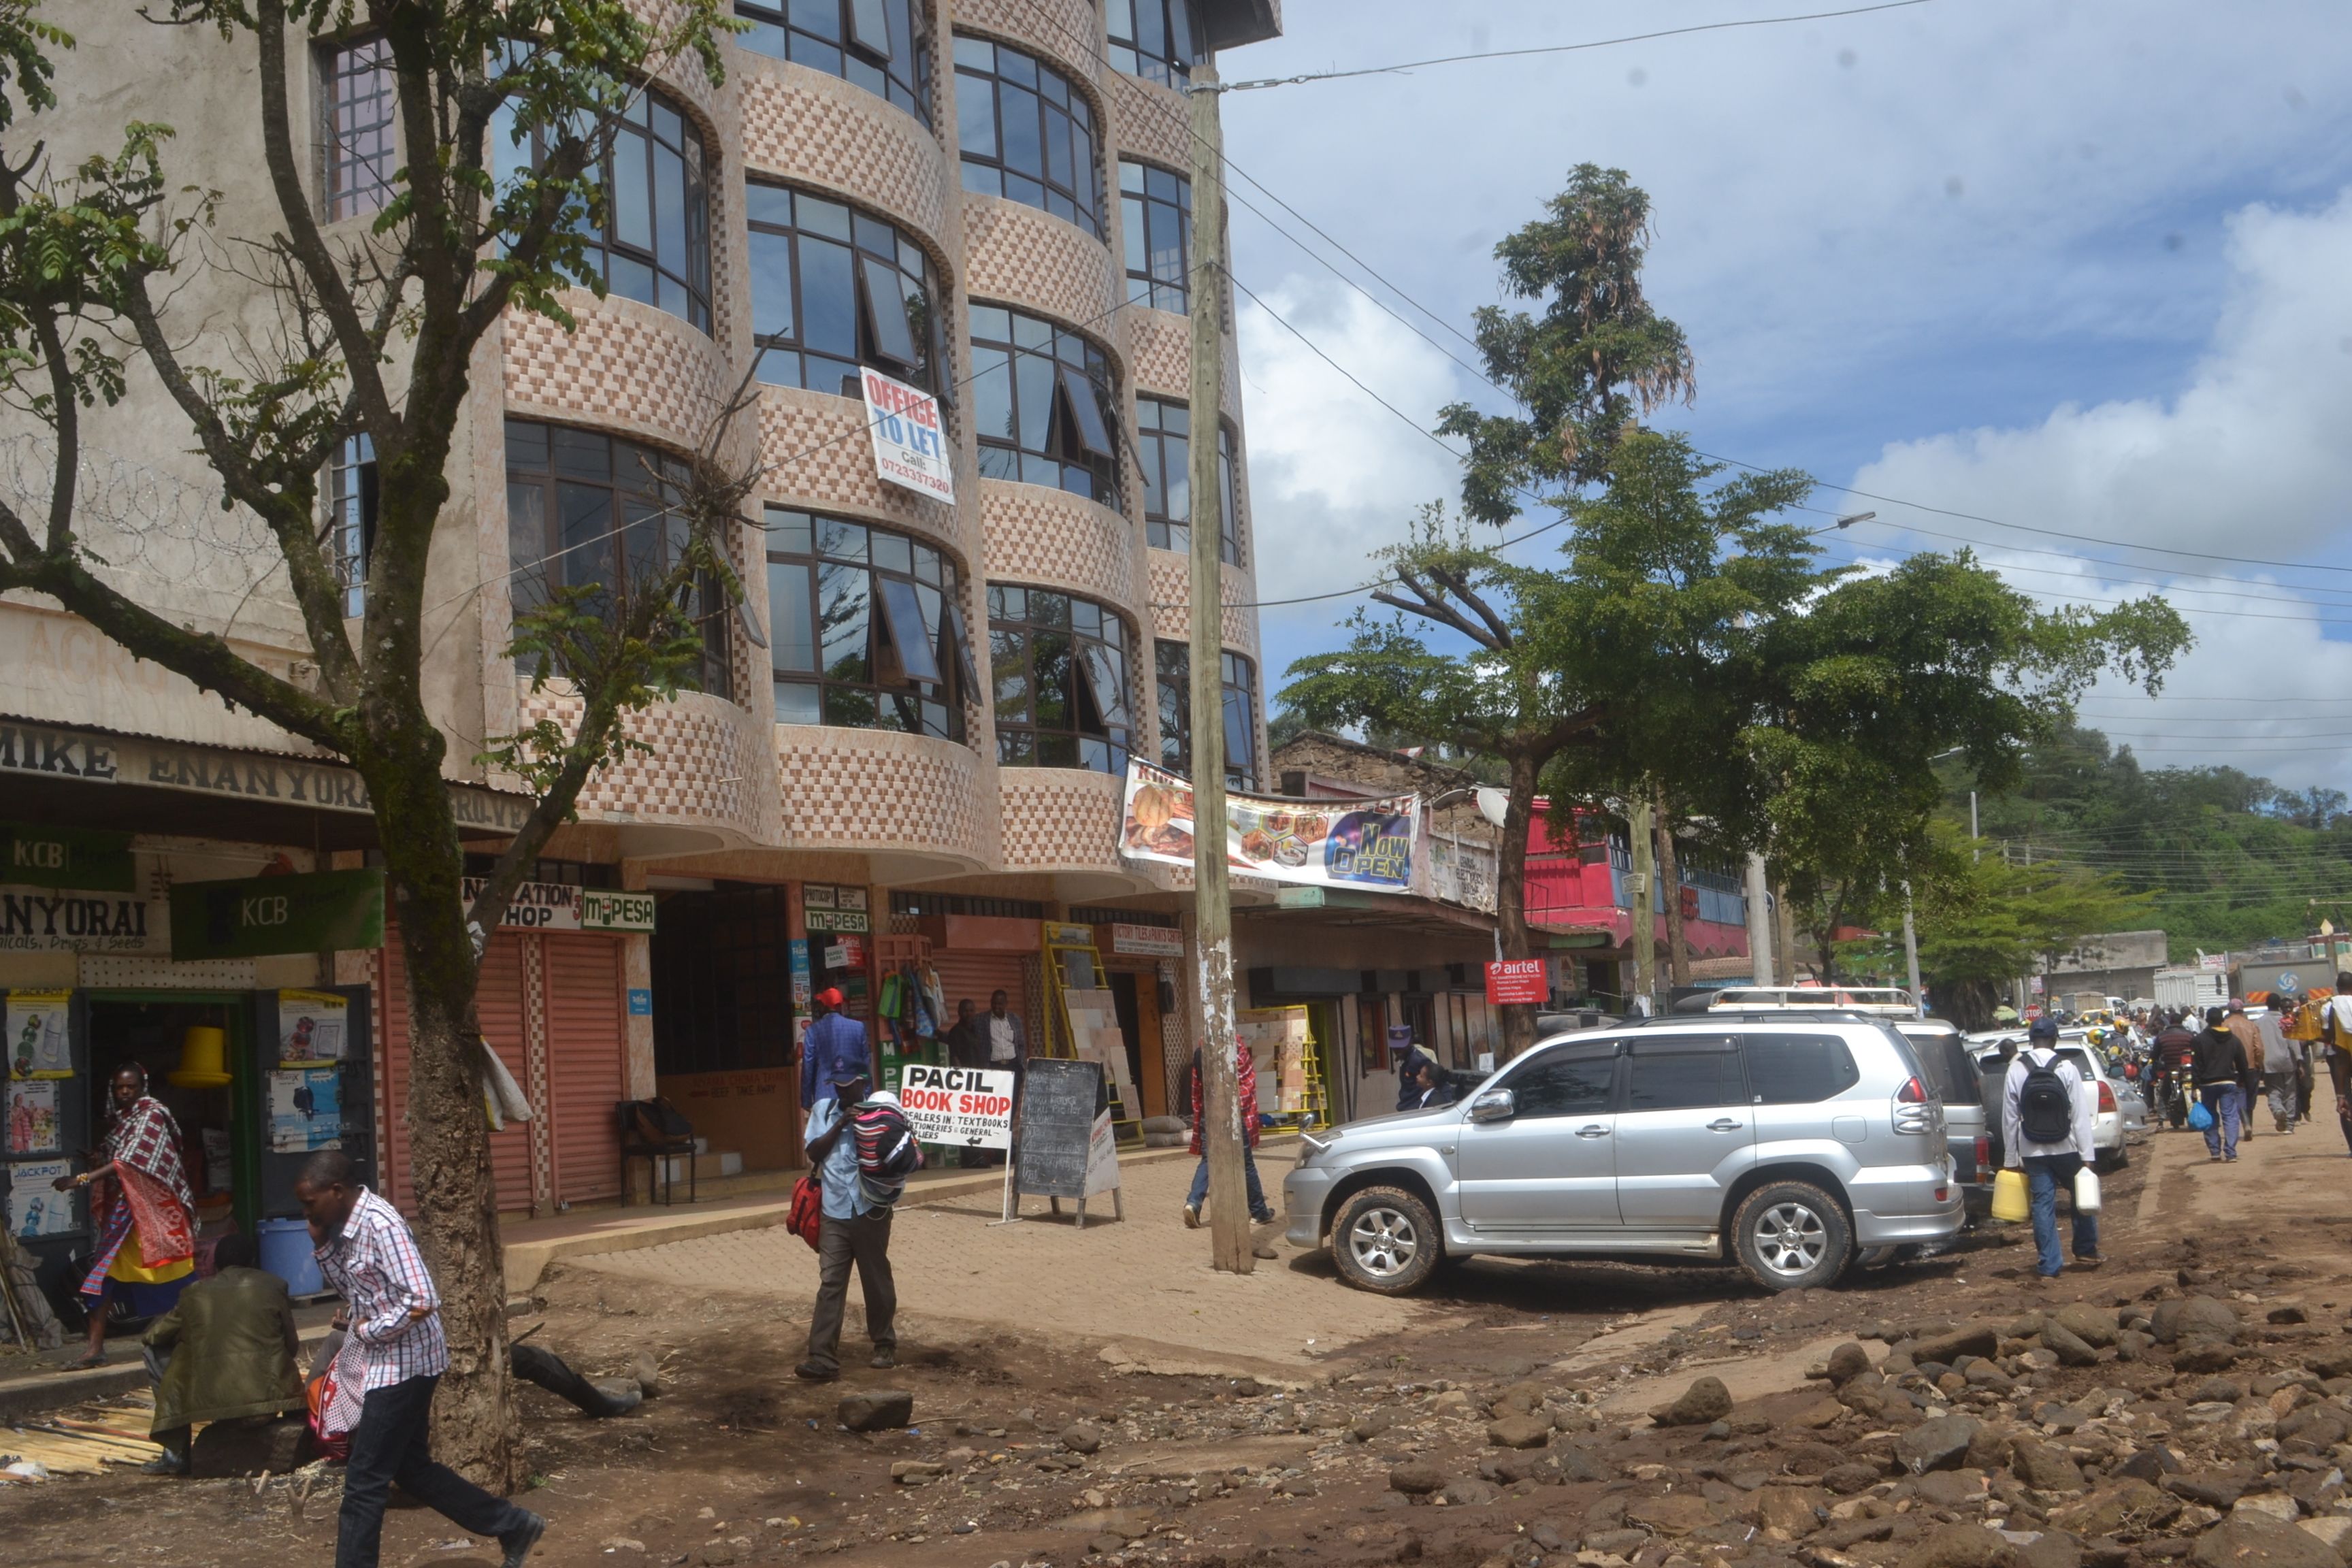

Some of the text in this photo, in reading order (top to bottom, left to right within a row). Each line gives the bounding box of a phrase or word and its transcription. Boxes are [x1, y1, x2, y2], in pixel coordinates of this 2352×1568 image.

[866, 374, 937, 429] OFFICE
[874, 407, 940, 459] TO LET
[901, 451, 926, 470] Call:
[881, 457, 949, 494] 0723337320
[14, 838, 64, 869] KCB
[1358, 822, 1410, 859] NOW
[1332, 845, 1407, 880] OPEN
[242, 895, 289, 927] KCB
[506, 906, 553, 926] HOP
[572, 895, 582, 921] 3
[50, 935, 88, 951] Drugs
[108, 934, 146, 949] Seeds
[1113, 924, 1134, 940] VICTORY
[1503, 960, 1540, 974] airtel
[2025, 1009, 2042, 1018] STOP
[909, 1067, 994, 1093] PACIL
[901, 1088, 1011, 1116] BOOK SHOP
[960, 1127, 992, 1137] GENERAL
[14, 1165, 63, 1179] JACKPOT
